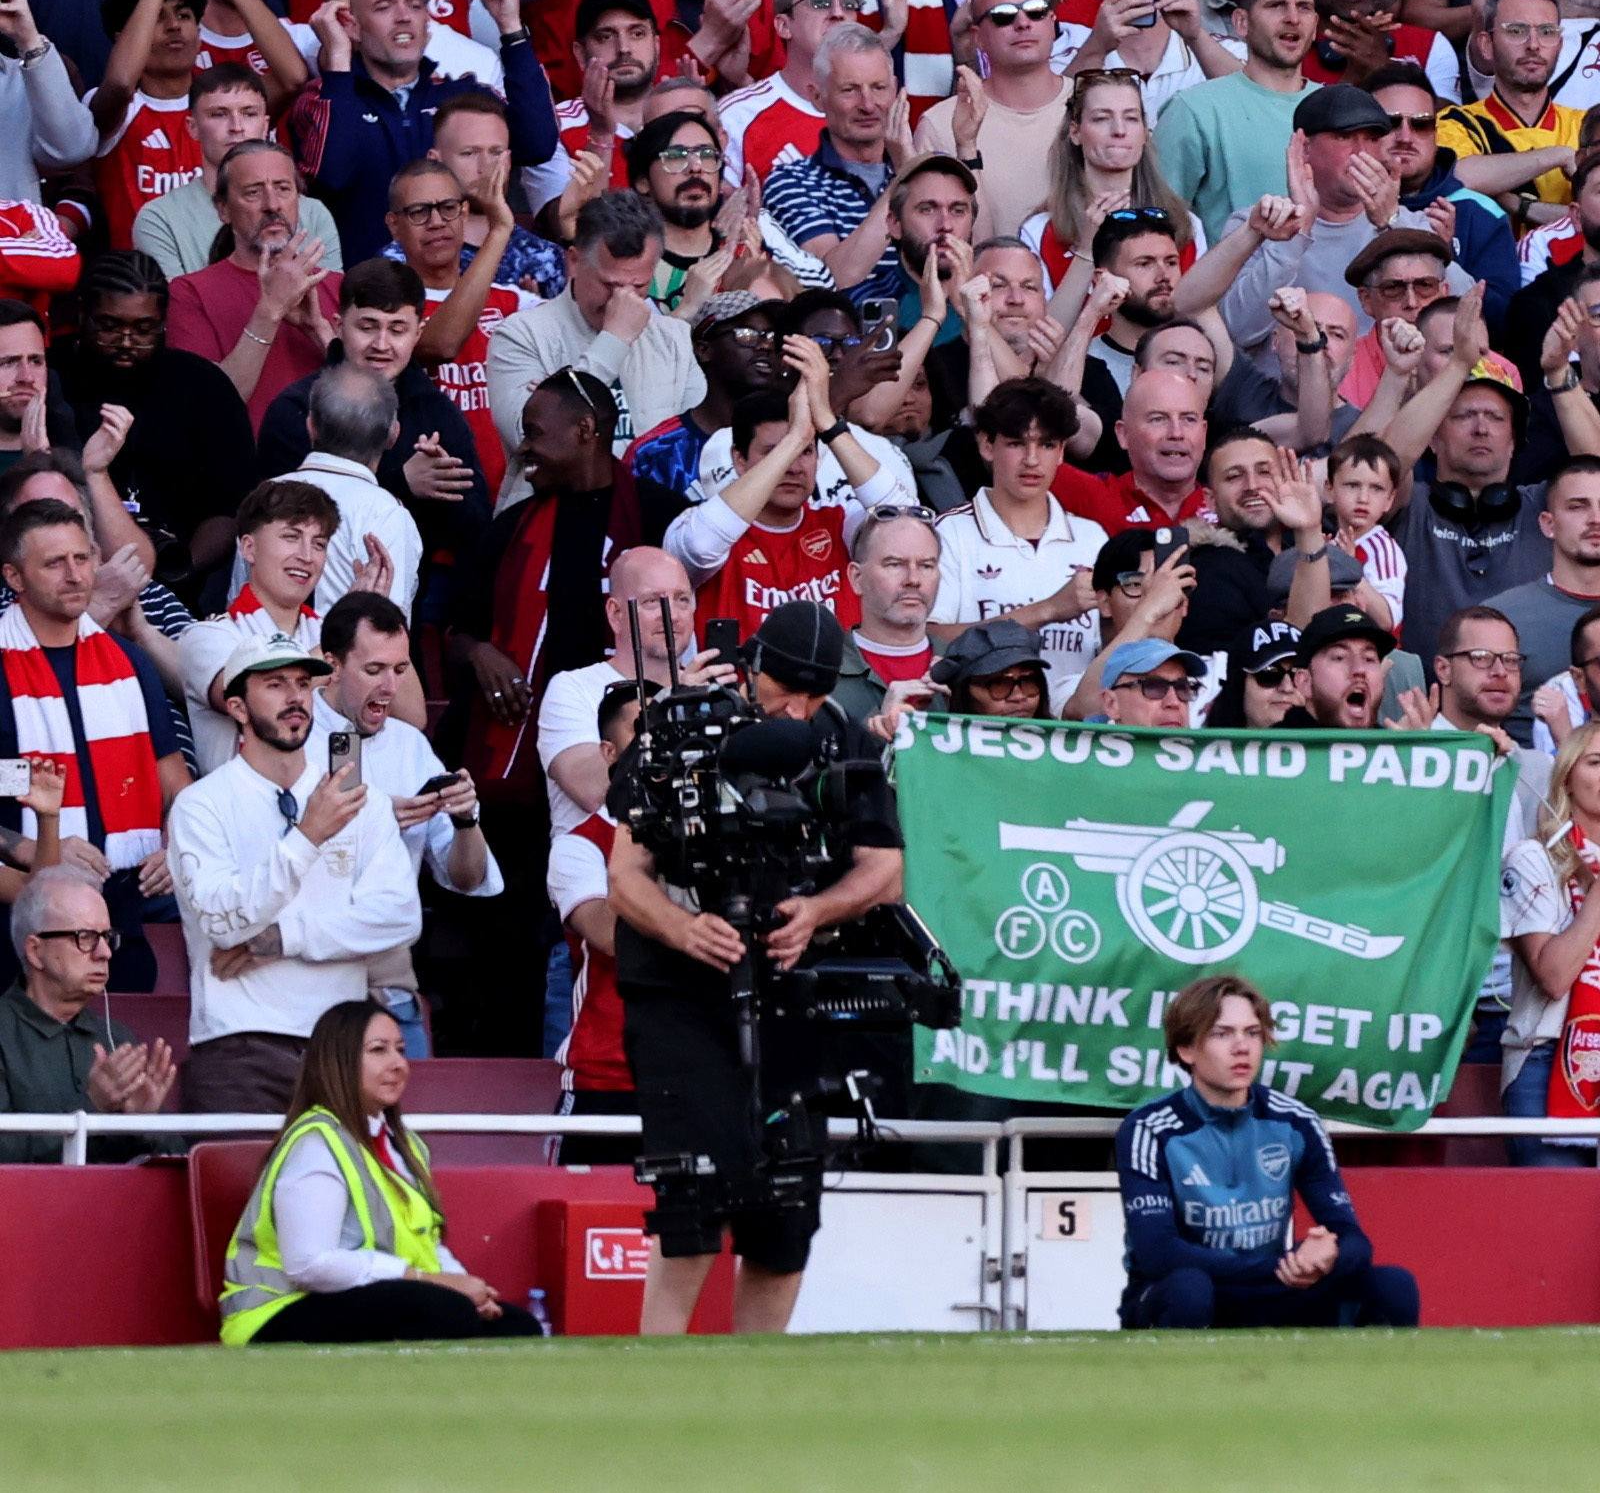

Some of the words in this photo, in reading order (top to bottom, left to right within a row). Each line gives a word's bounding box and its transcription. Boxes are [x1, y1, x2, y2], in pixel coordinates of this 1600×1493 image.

[1043, 627, 1083, 654] ETTER
[1153, 737, 1307, 779] SAID
[1036, 871, 1059, 902] A
[1009, 916, 1032, 950] F
[1063, 918, 1086, 954] C
[965, 980, 1132, 1028] THINK
[1270, 1002, 1373, 1049] GET
[931, 1028, 990, 1075] AD
[1002, 1040, 1089, 1083] I'LL
[1105, 1045, 1191, 1087] SIN
